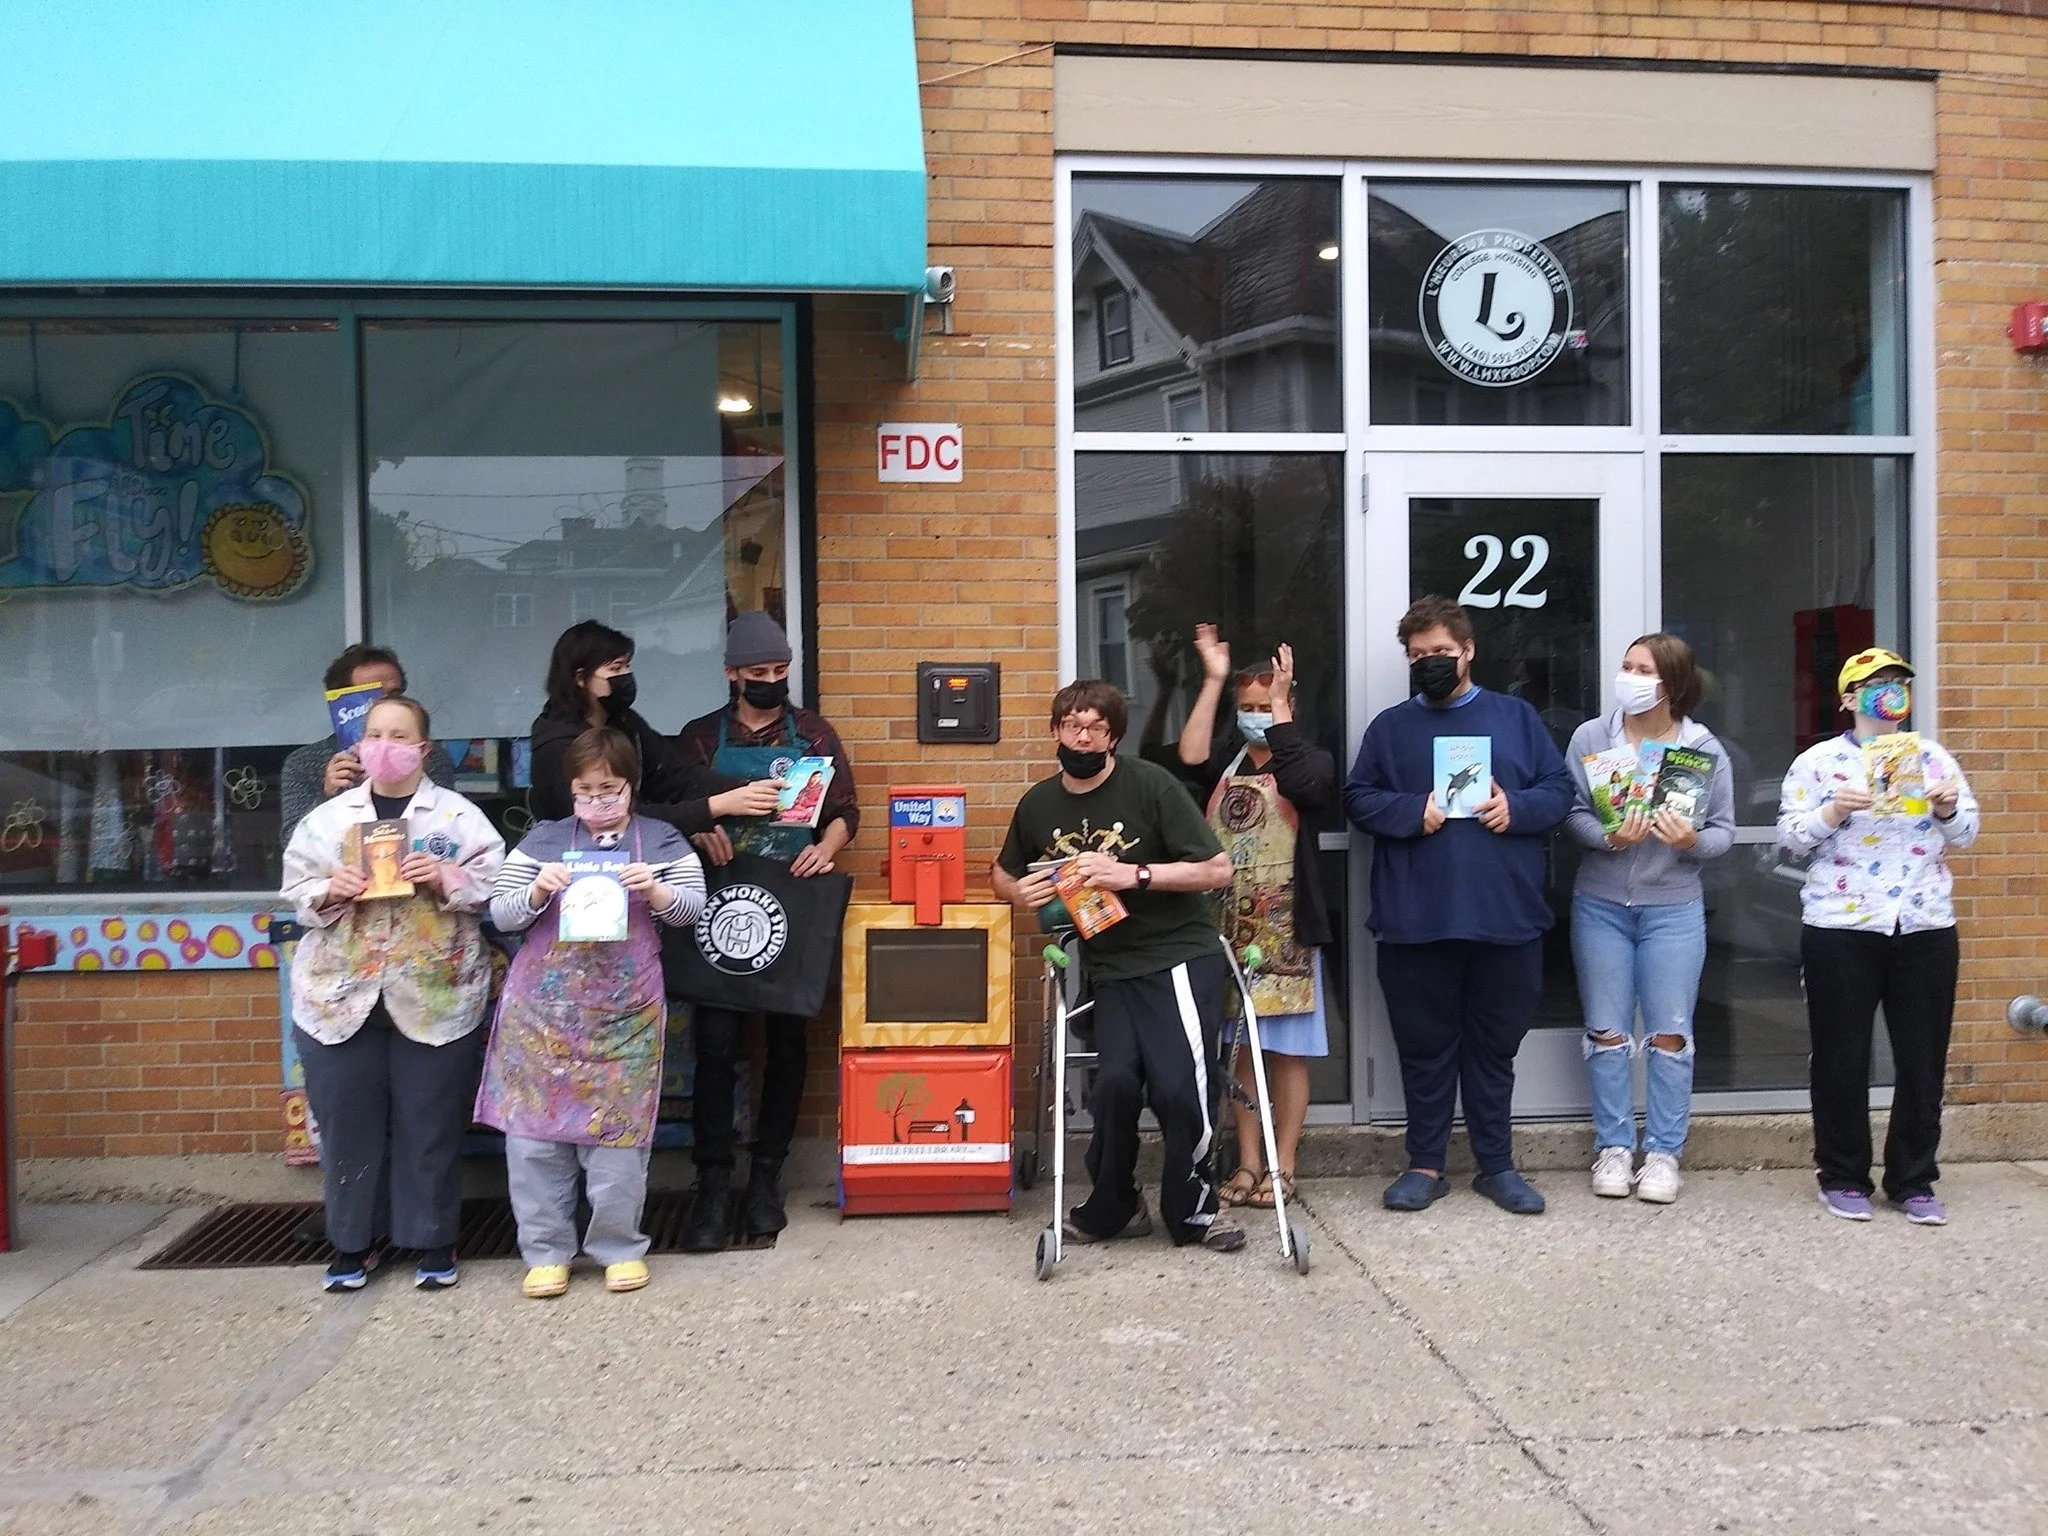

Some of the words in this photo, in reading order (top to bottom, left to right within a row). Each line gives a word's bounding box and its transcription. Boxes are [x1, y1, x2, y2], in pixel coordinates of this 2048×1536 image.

[1426, 235, 1488, 296] L'HEUREUX
[1494, 234, 1565, 294] PROPERTIES
[1451, 253, 1490, 281] COLLEGE
[1495, 253, 1538, 279] HOUSING
[881, 435, 959, 470] FDC
[1457, 534, 1550, 609] 22
[894, 801, 932, 813] United
[908, 812, 931, 826] Way
[697, 896, 723, 964] PASSION
[721, 887, 778, 914] WORKS
[751, 913, 785, 969] STUDIO
